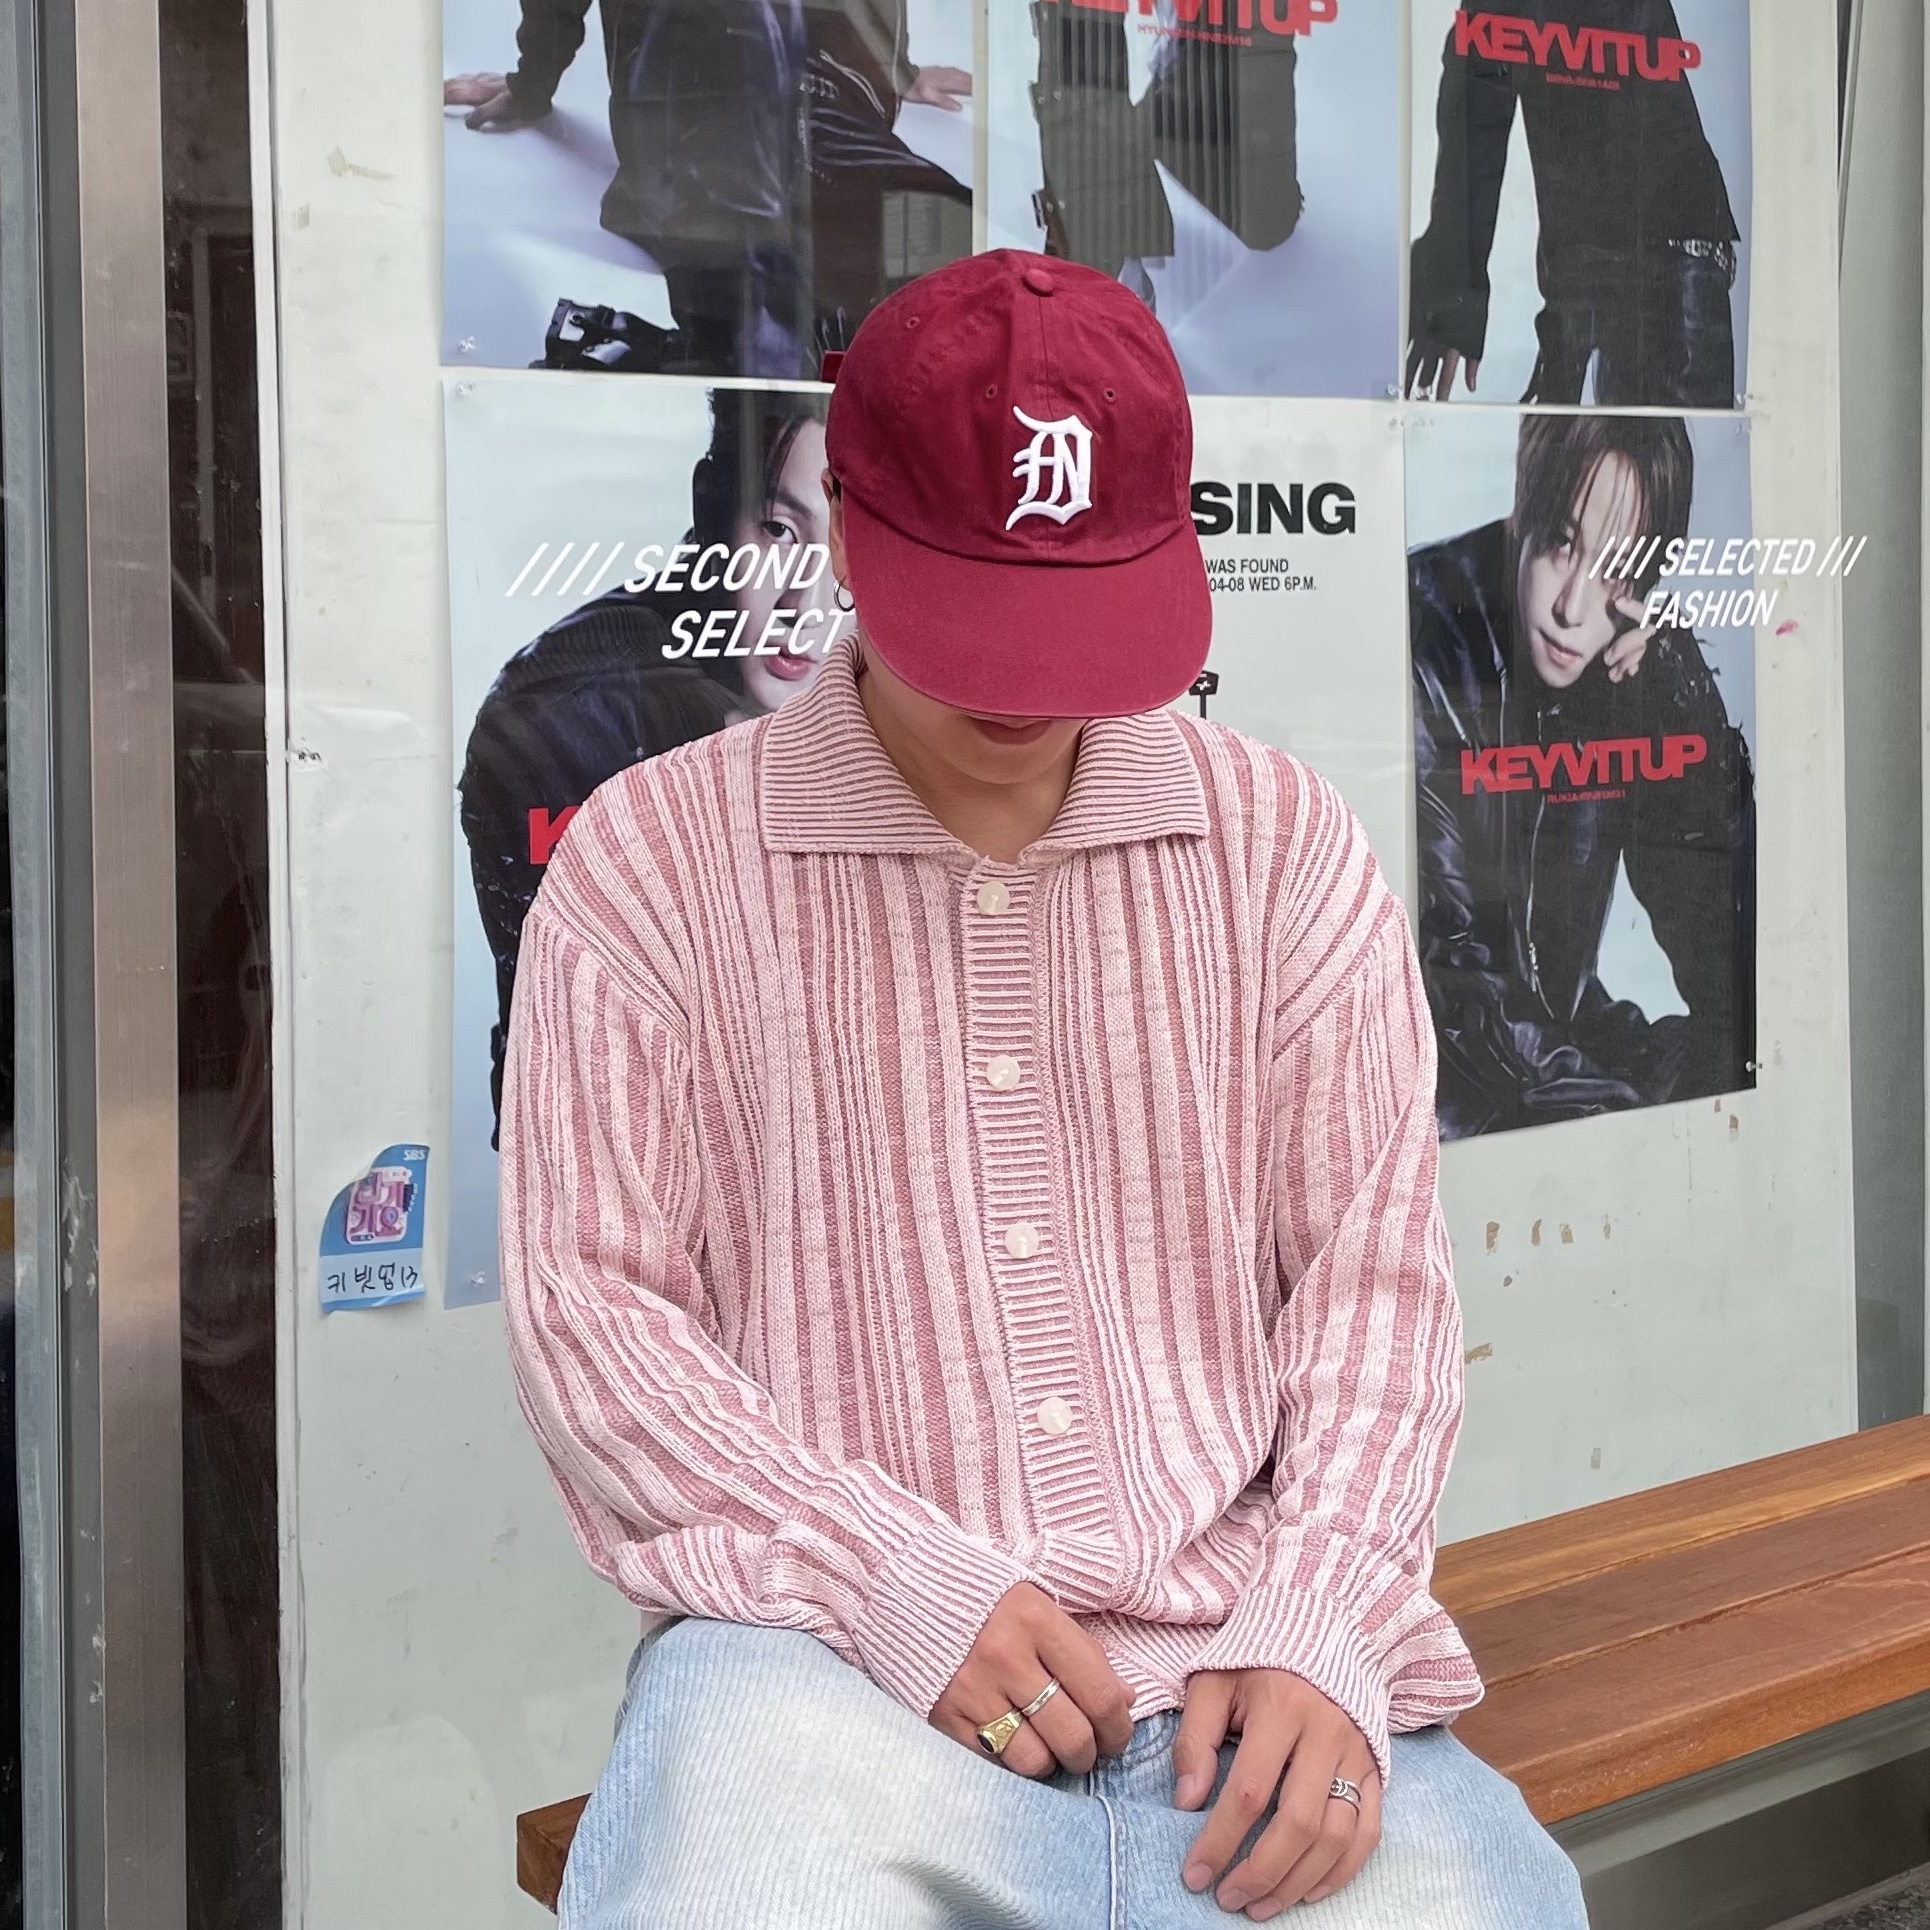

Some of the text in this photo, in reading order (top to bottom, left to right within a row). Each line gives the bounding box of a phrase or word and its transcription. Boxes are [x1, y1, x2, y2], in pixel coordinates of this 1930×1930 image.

[1190, 481, 1356, 535] SING
[624, 543, 830, 593] SECOND
[1205, 558, 1289, 574] WAS FOUND
[1659, 536, 1816, 577] SELECTED
[1250, 577, 1280, 591] WED
[1284, 576, 1317, 591] 6P.M.
[1640, 589, 1779, 629] FASHION
[662, 608, 855, 659] SELECT
